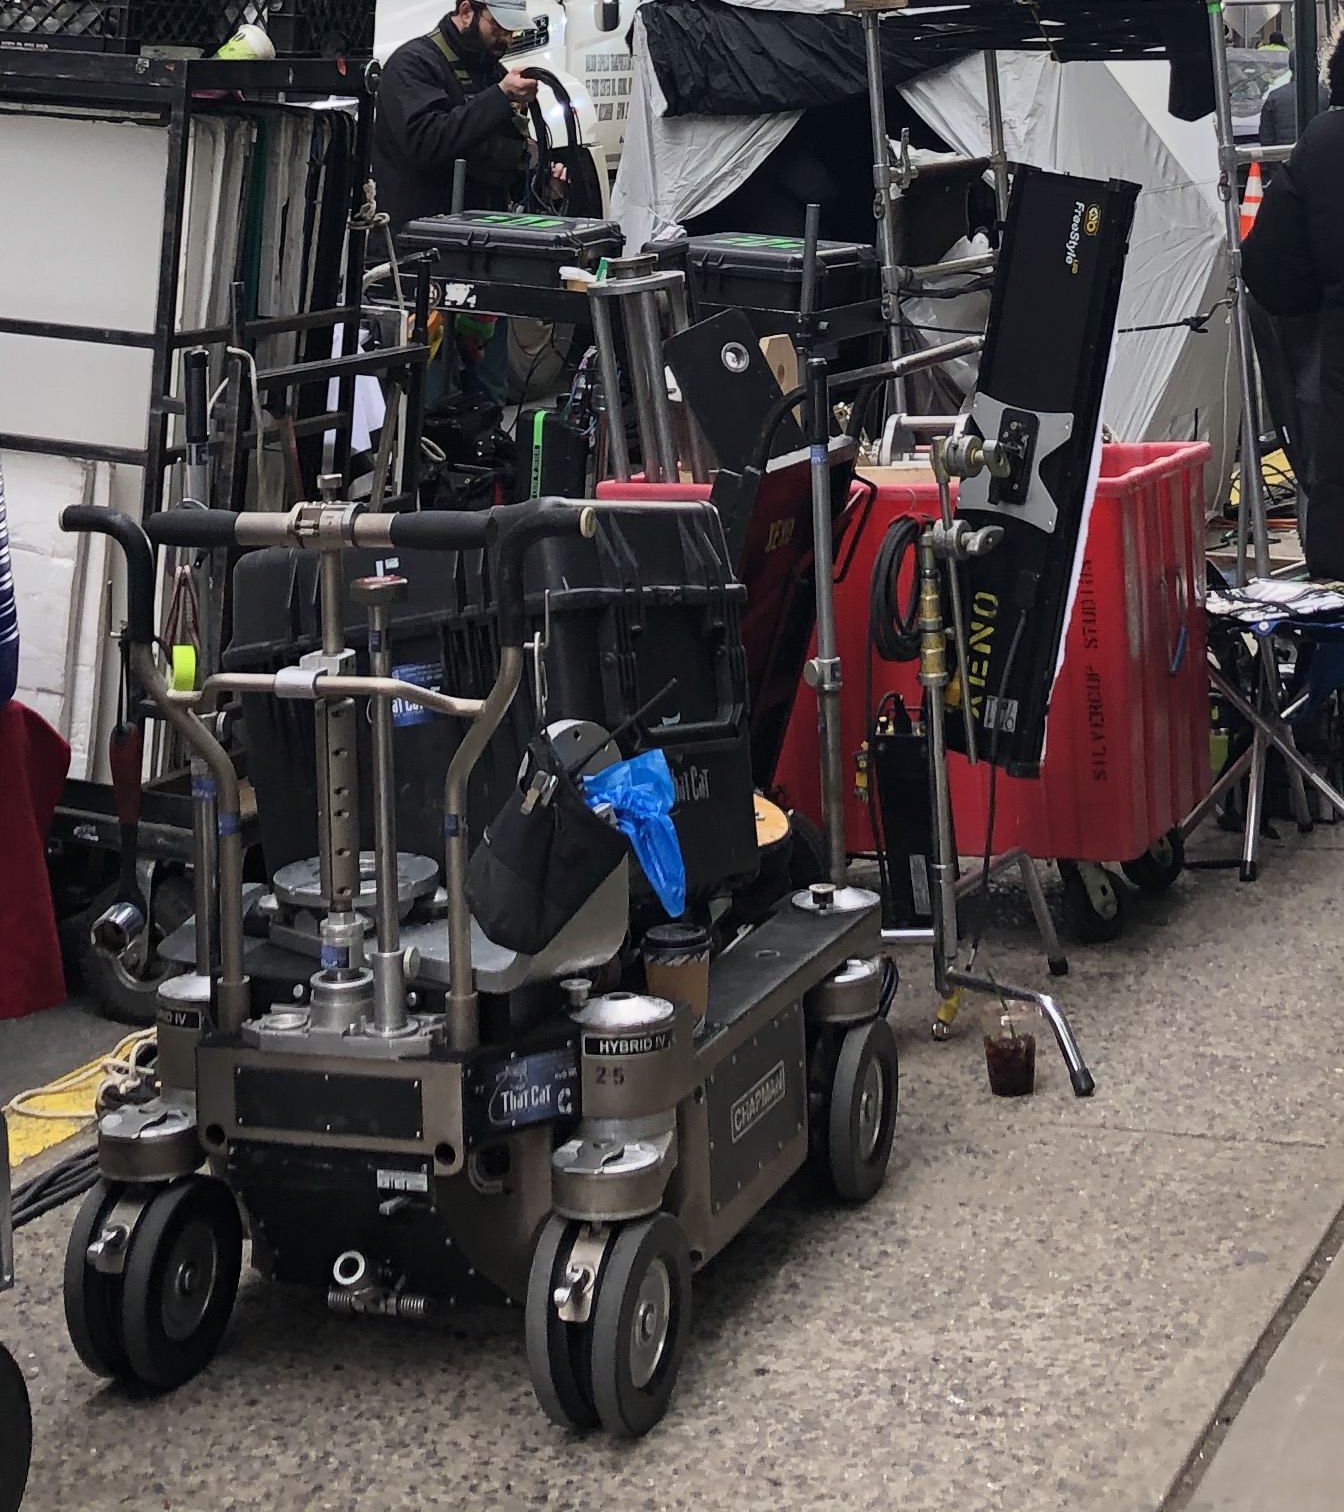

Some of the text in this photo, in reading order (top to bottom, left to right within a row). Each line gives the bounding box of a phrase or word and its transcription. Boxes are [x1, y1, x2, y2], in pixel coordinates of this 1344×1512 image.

[1065, 201, 1086, 265] FreeStyle
[599, 1037, 653, 1054] HYBRID
[734, 1068, 783, 1131] CHAPMAN
